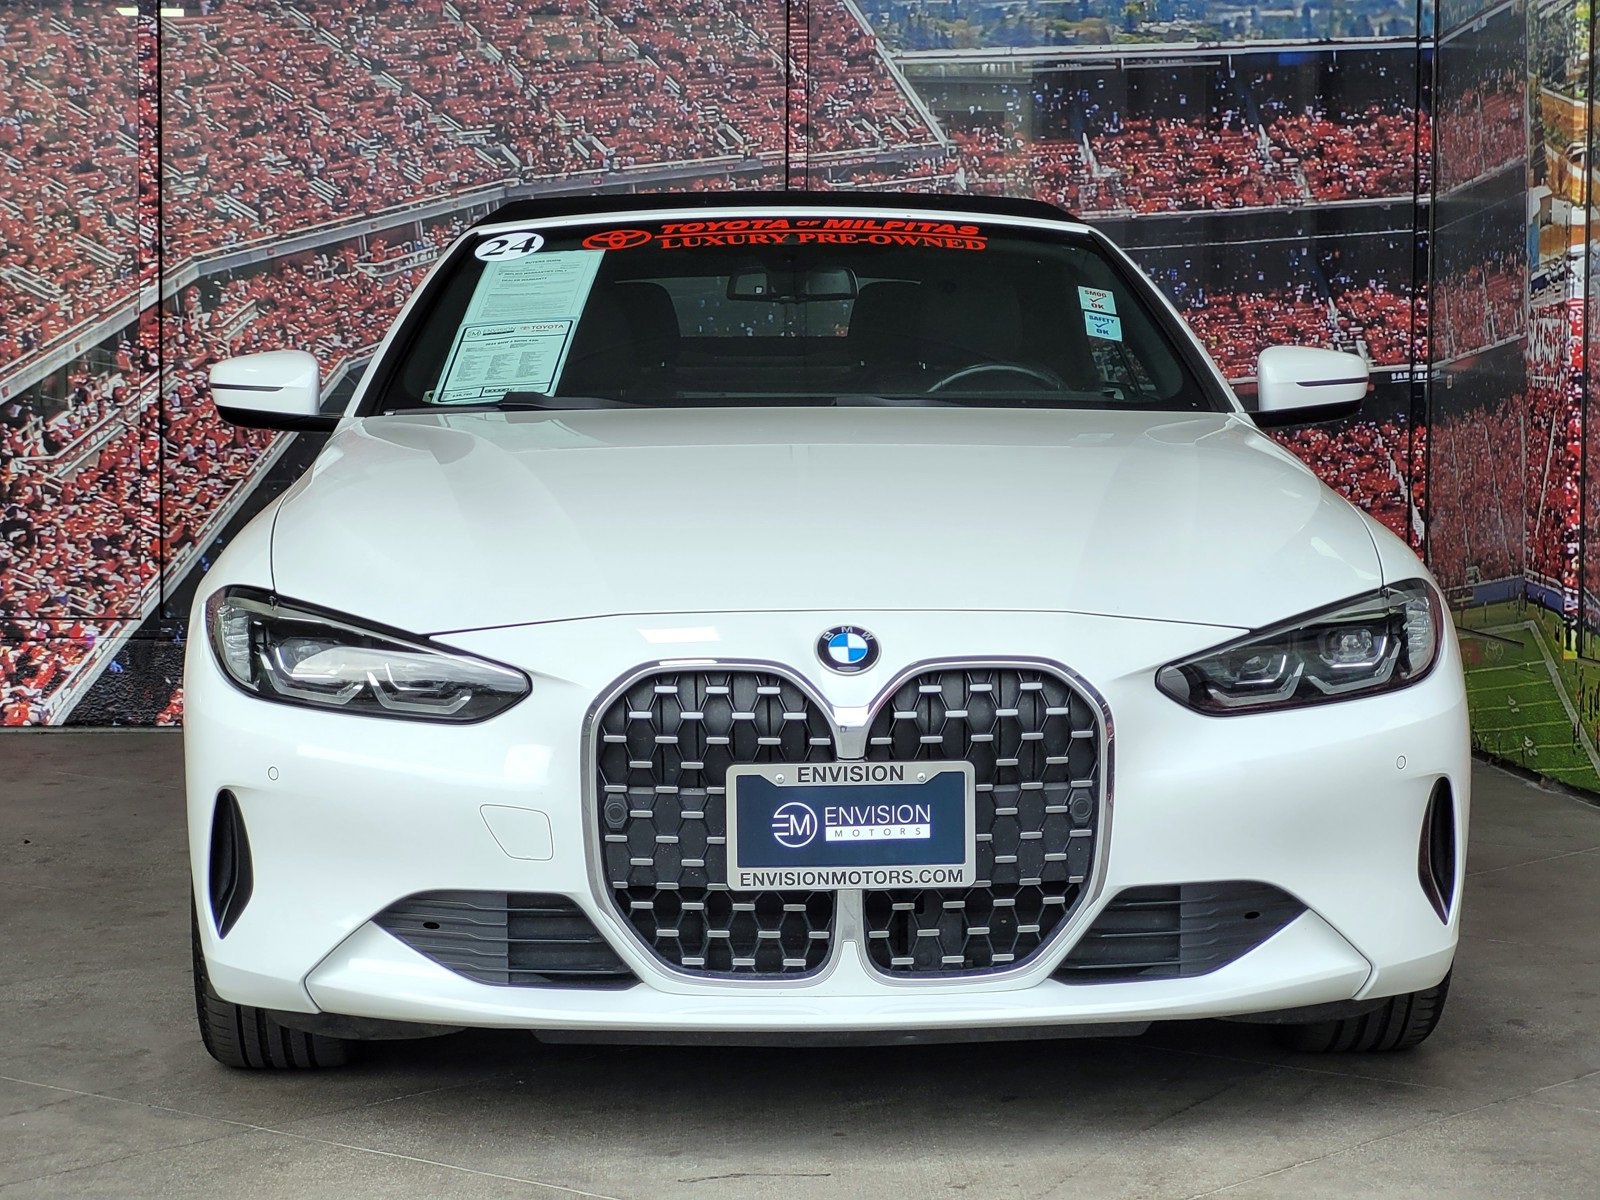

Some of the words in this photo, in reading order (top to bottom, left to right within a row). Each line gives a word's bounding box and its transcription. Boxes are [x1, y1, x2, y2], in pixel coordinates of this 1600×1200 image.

[660, 219, 790, 234] TOYOTA
[823, 219, 981, 235] MILPITAS
[480, 236, 537, 257] 24
[660, 234, 790, 249] LUXURY
[797, 233, 987, 250] PRE-OWNED
[1084, 290, 1107, 298] SMOG
[822, 626, 874, 641] BMW
[797, 765, 904, 783] ENVISION
[824, 804, 931, 826] ENVISION
[834, 827, 921, 838] MOTORS
[740, 869, 963, 887] ENVISIONMOTORS.COM
